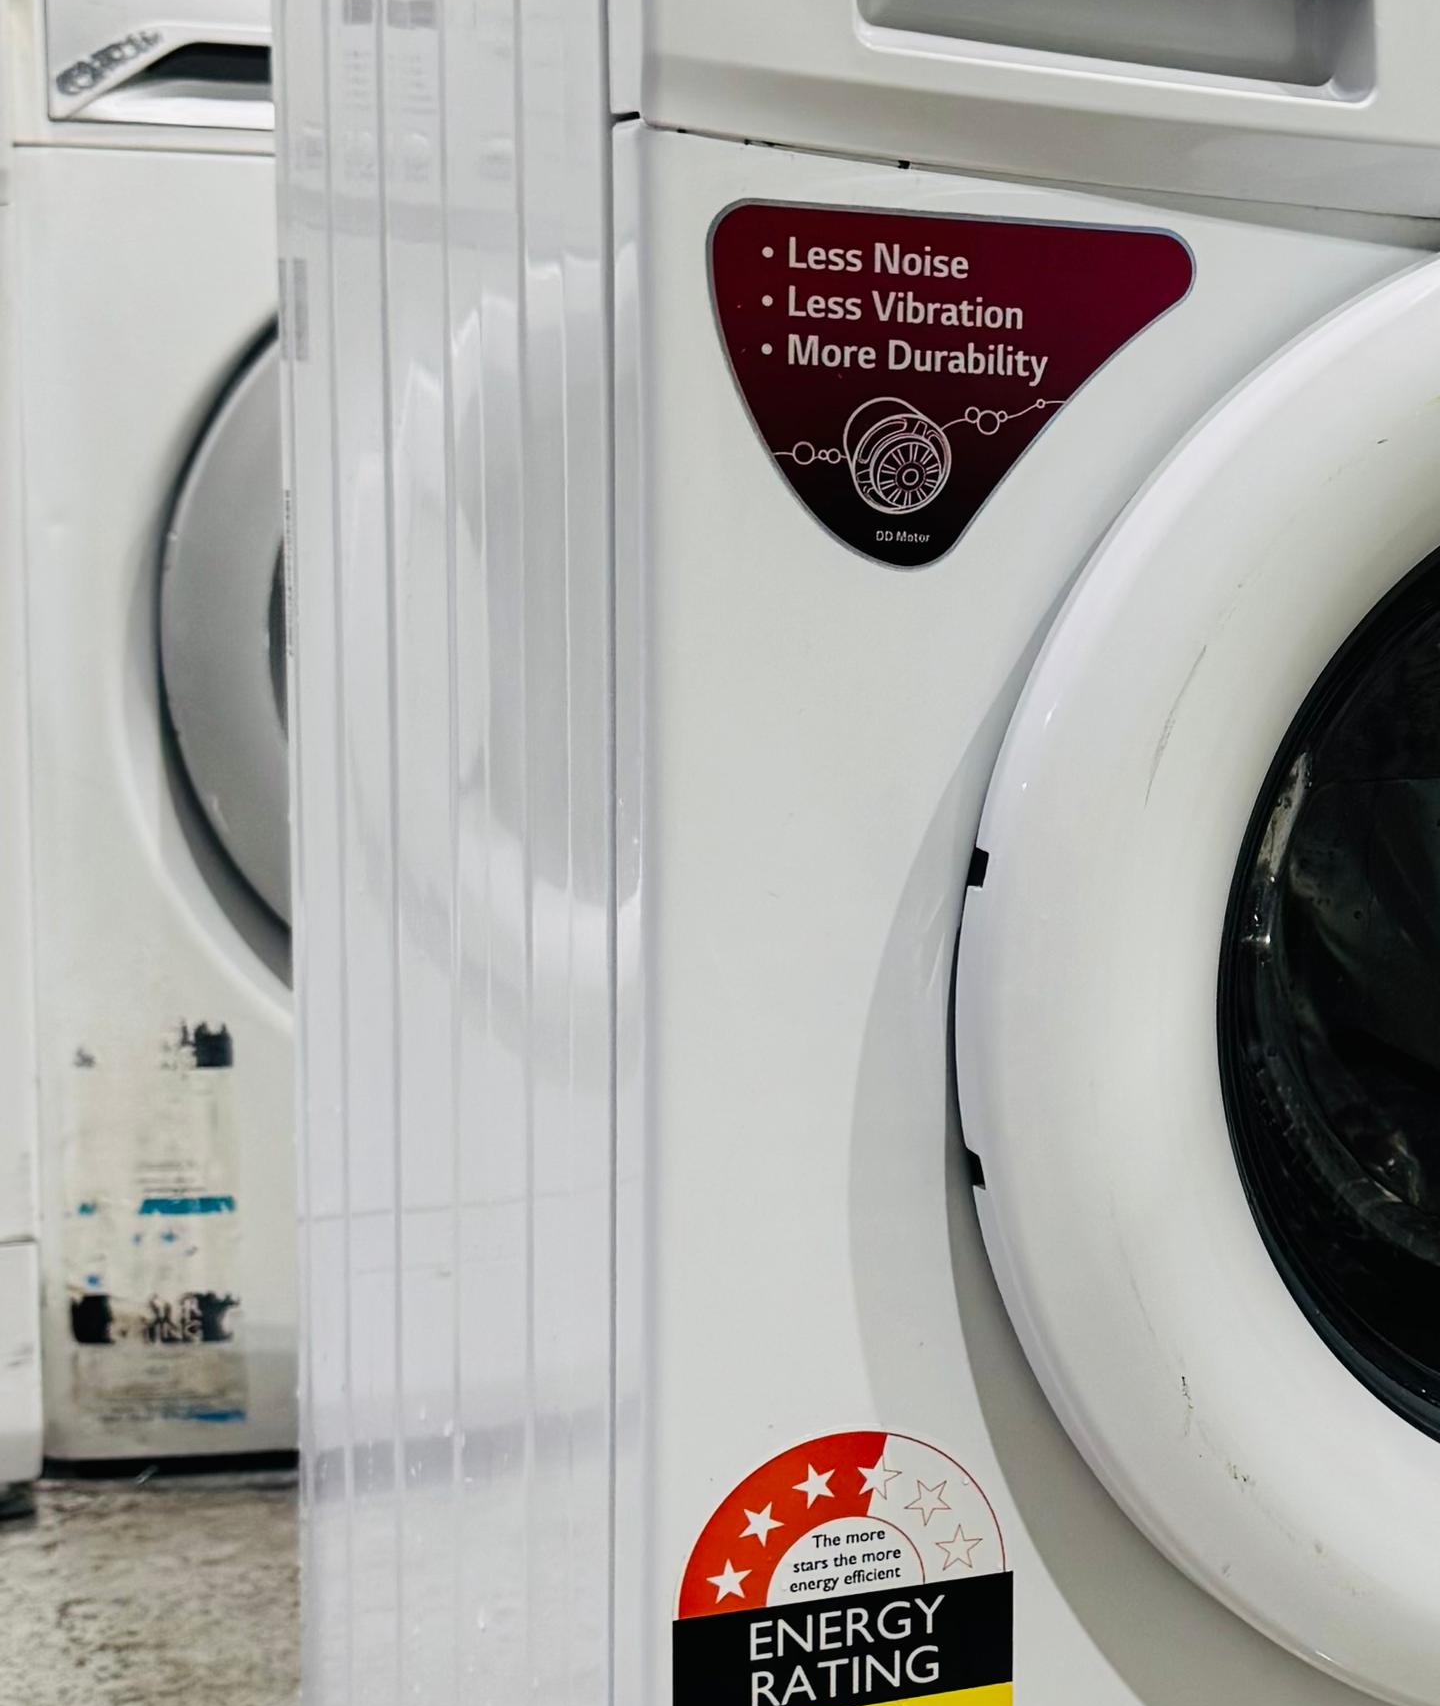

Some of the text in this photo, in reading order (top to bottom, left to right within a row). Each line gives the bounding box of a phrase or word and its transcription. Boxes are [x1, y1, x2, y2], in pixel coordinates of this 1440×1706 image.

[788, 236, 969, 279] Less Noise
[788, 285, 1024, 330] Less Vibration
[787, 334, 1048, 387] More Durability
[876, 530, 930, 543] DD Motor
[812, 1530, 885, 1548] The more
[793, 1549, 901, 1573] stars the more
[790, 1567, 901, 1592] energy efficient
[750, 1594, 945, 1661] ENERGY
